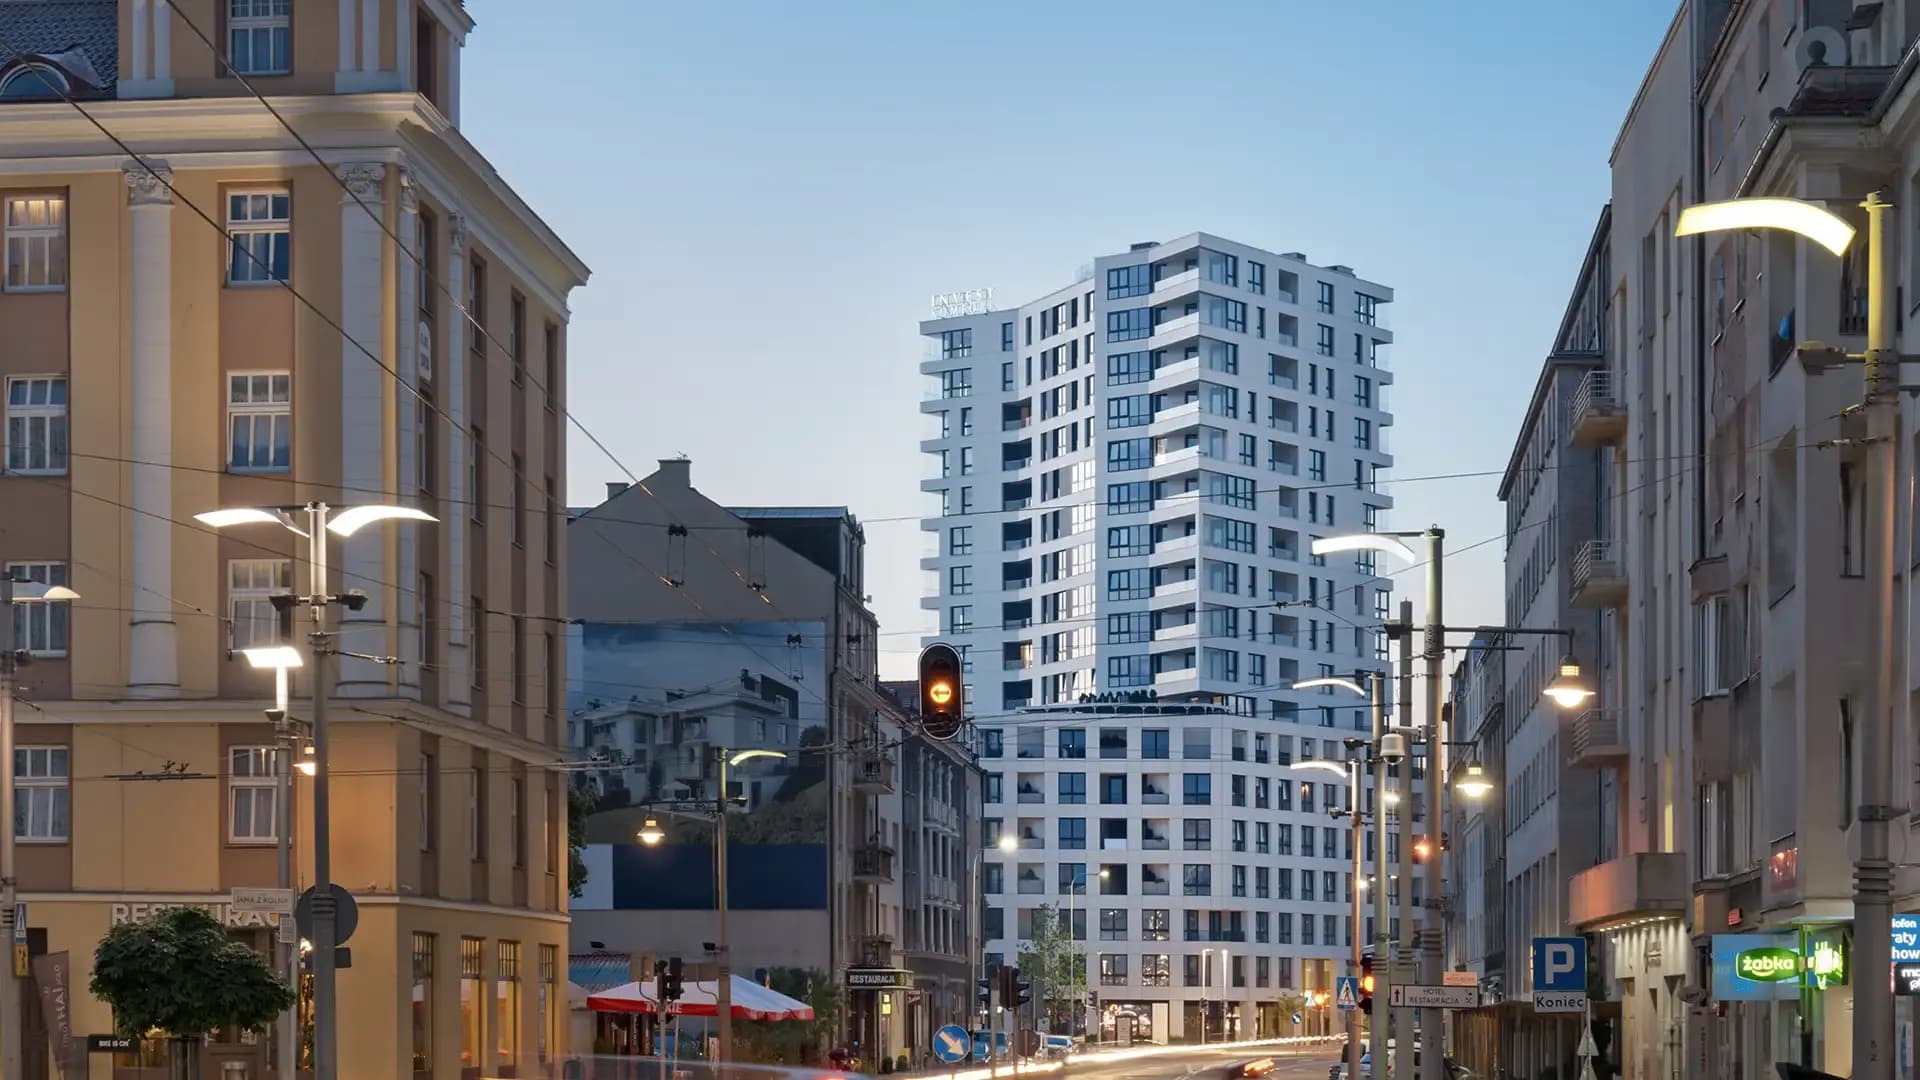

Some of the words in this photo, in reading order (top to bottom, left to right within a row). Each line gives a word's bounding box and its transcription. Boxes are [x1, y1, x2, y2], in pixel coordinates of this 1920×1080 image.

[1545, 944, 1575, 984] P
[1743, 956, 1794, 971] żabka
[849, 974, 896, 984] RESTAURACJA
[1409, 996, 1460, 1005] RESTAURACJA
[1536, 996, 1584, 1008] Koniec
[645, 1001, 683, 1014] TYKIE
